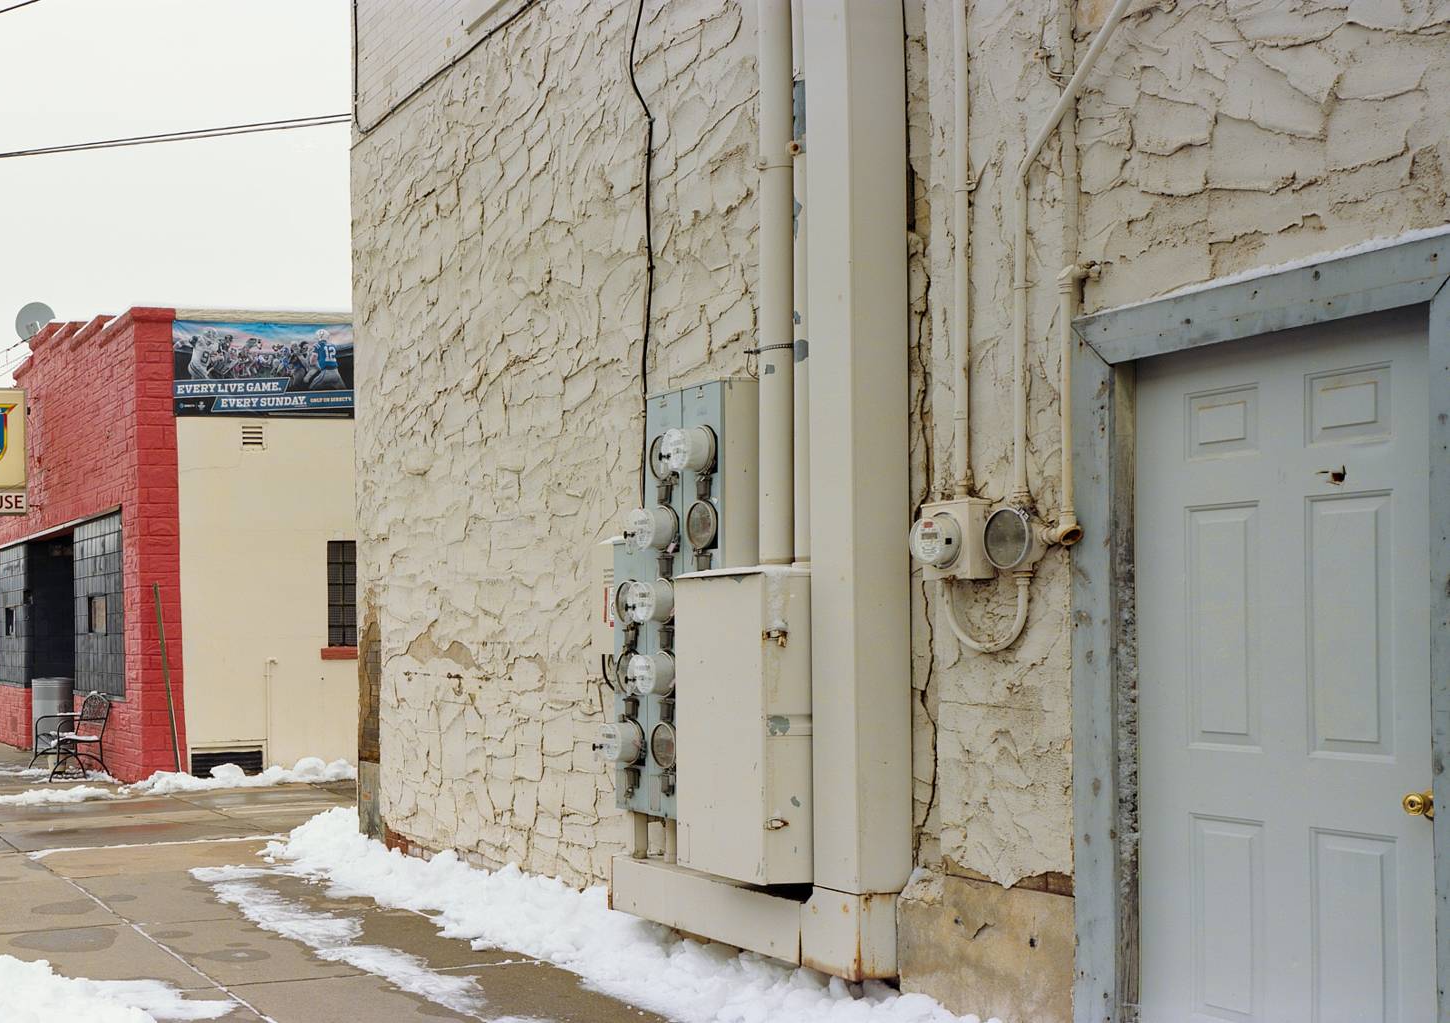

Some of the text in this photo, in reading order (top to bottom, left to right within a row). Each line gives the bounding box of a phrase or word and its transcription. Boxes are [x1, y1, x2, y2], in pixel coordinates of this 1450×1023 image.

[323, 345, 337, 359] 12
[176, 381, 282, 395] EVERY LIVE GAME.
[221, 396, 307, 408] EVERY SUNDAY.
